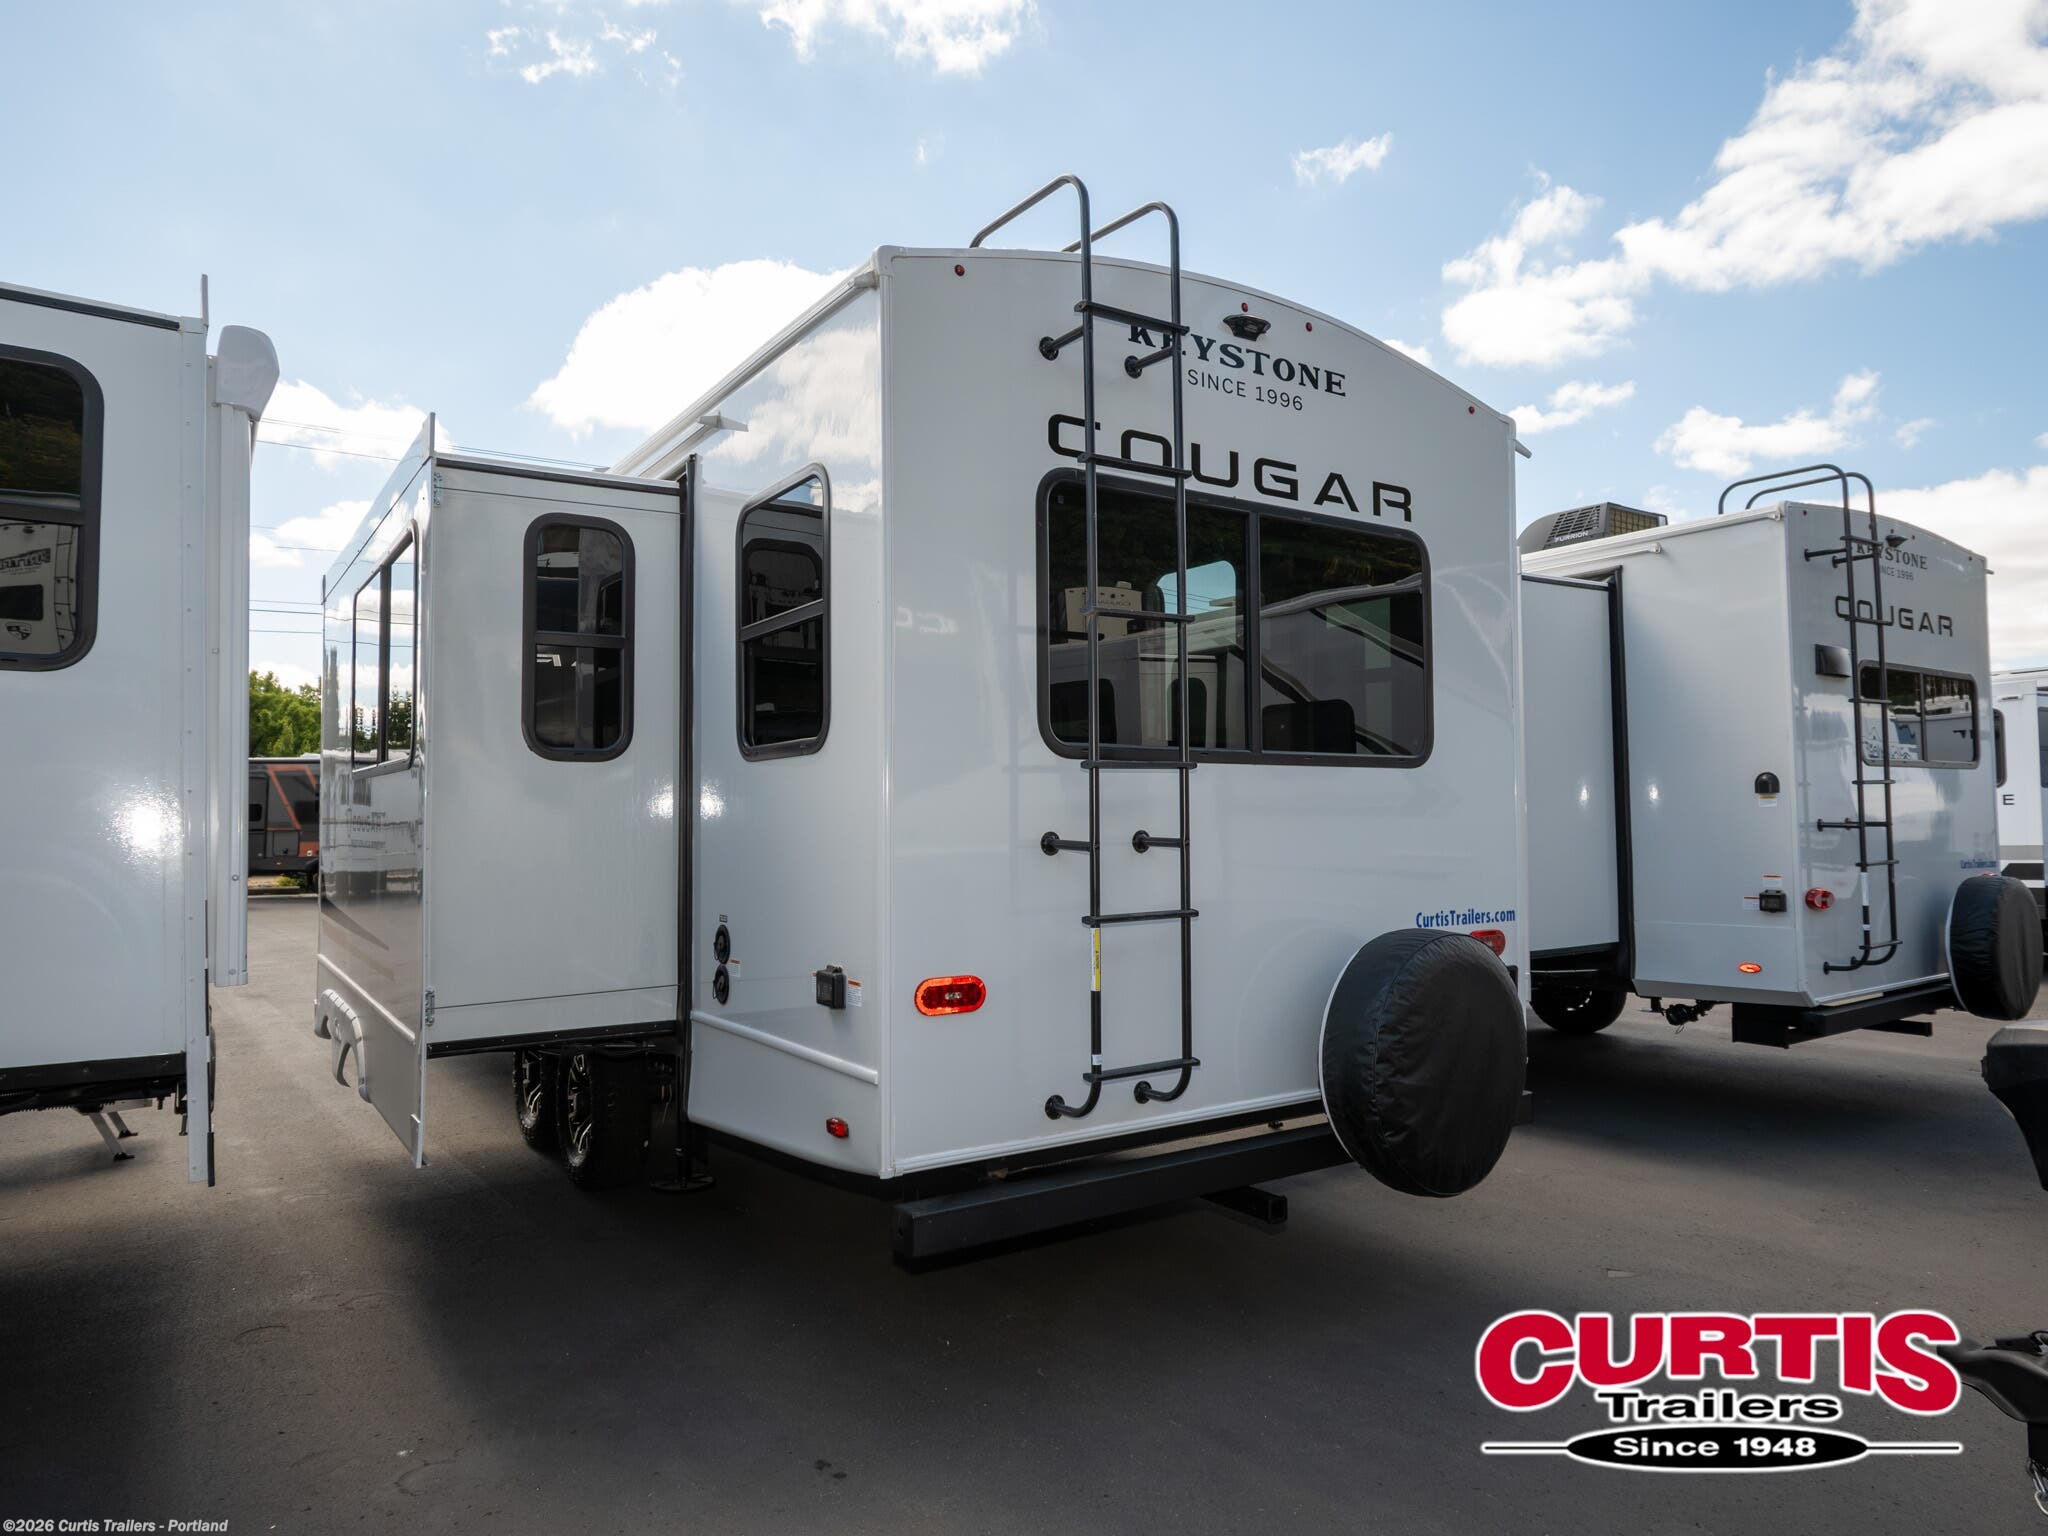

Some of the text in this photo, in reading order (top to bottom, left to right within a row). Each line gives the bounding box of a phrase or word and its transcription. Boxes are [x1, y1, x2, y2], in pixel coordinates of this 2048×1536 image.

[1187, 369, 1304, 412] SINCE 1996
[1047, 413, 1413, 523] COUGAR
[1415, 908, 1517, 929] CurtisTrailers.com
